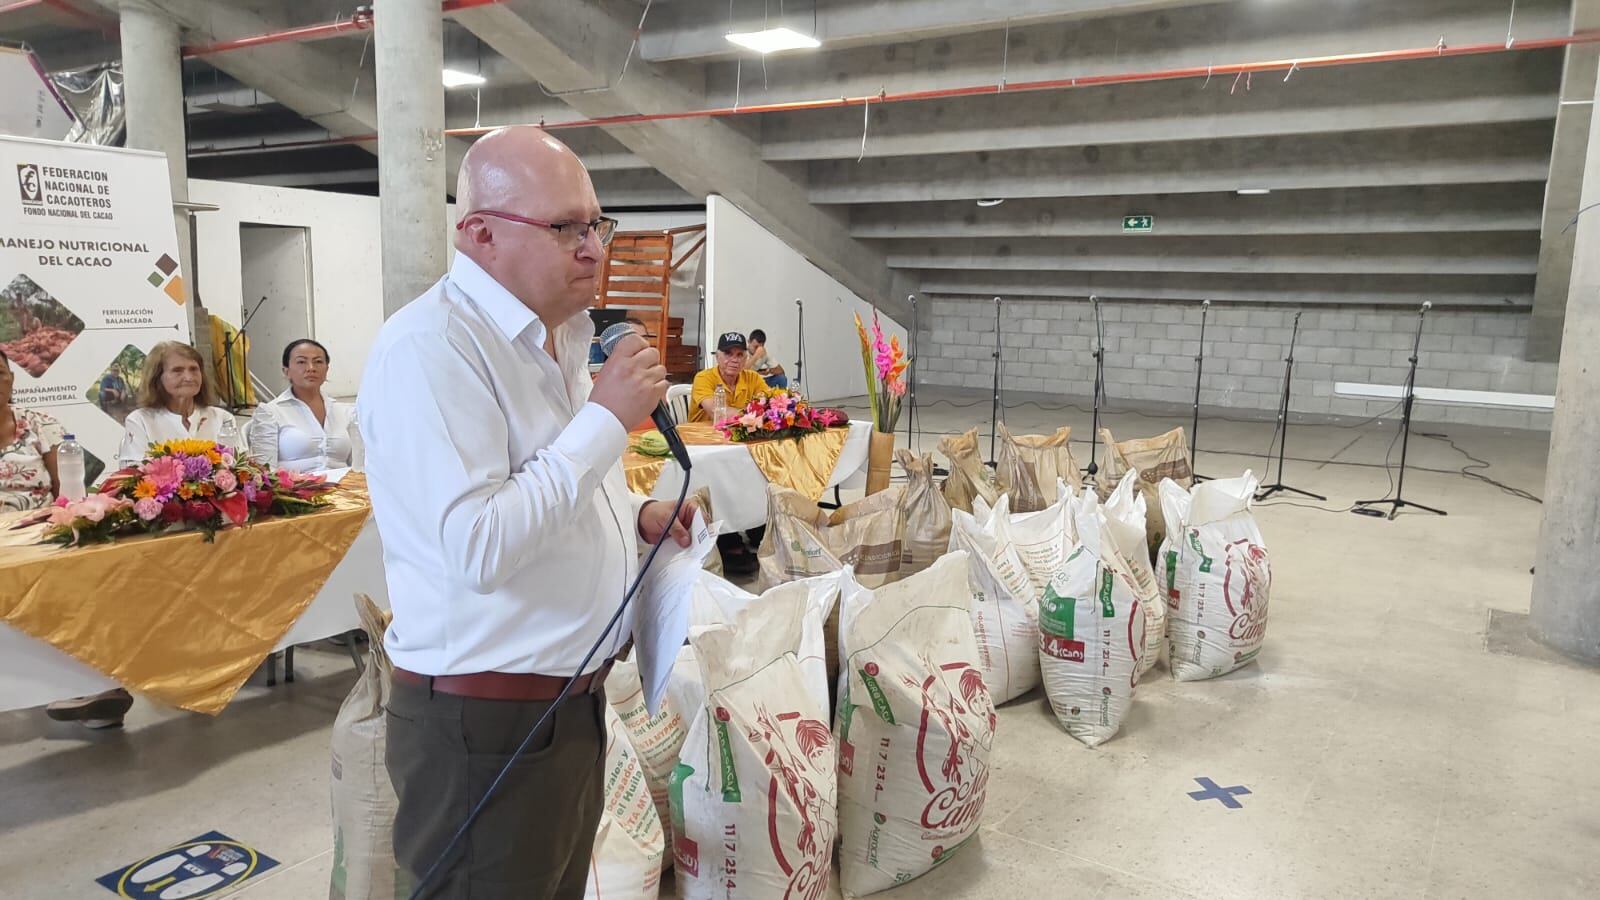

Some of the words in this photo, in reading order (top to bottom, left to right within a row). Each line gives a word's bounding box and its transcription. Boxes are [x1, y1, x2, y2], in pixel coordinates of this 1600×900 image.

[42, 167, 109, 182] FEDERACION
[44, 180, 95, 195] NACIONAL
[97, 185, 110, 195] DE
[46, 194, 112, 209] CACAOTEROS
[23, 207, 46, 217] FONDO
[48, 208, 78, 219] NACIONAL
[80, 210, 91, 220] DEL
[93, 211, 113, 221] CACAO
[59, 239, 150, 253] NUTRICIONAL
[38, 255, 63, 267] DEL
[66, 256, 113, 267] CACAO
[102, 307, 154, 317] FERTILIZACIÓN
[105, 317, 153, 325] BALANCEADA
[39, 393, 77, 403] INTEGRAL
[880, 737, 890, 748] 11
[621, 749, 629, 760] y
[879, 751, 888, 761] 7
[876, 765, 886, 780] 23
[623, 769, 643, 802] Huila
[875, 783, 884, 792] 4
[724, 823, 737, 836] 11
[726, 844, 736, 852] 7
[724, 860, 737, 875] 23
[725, 881, 737, 889] 4
